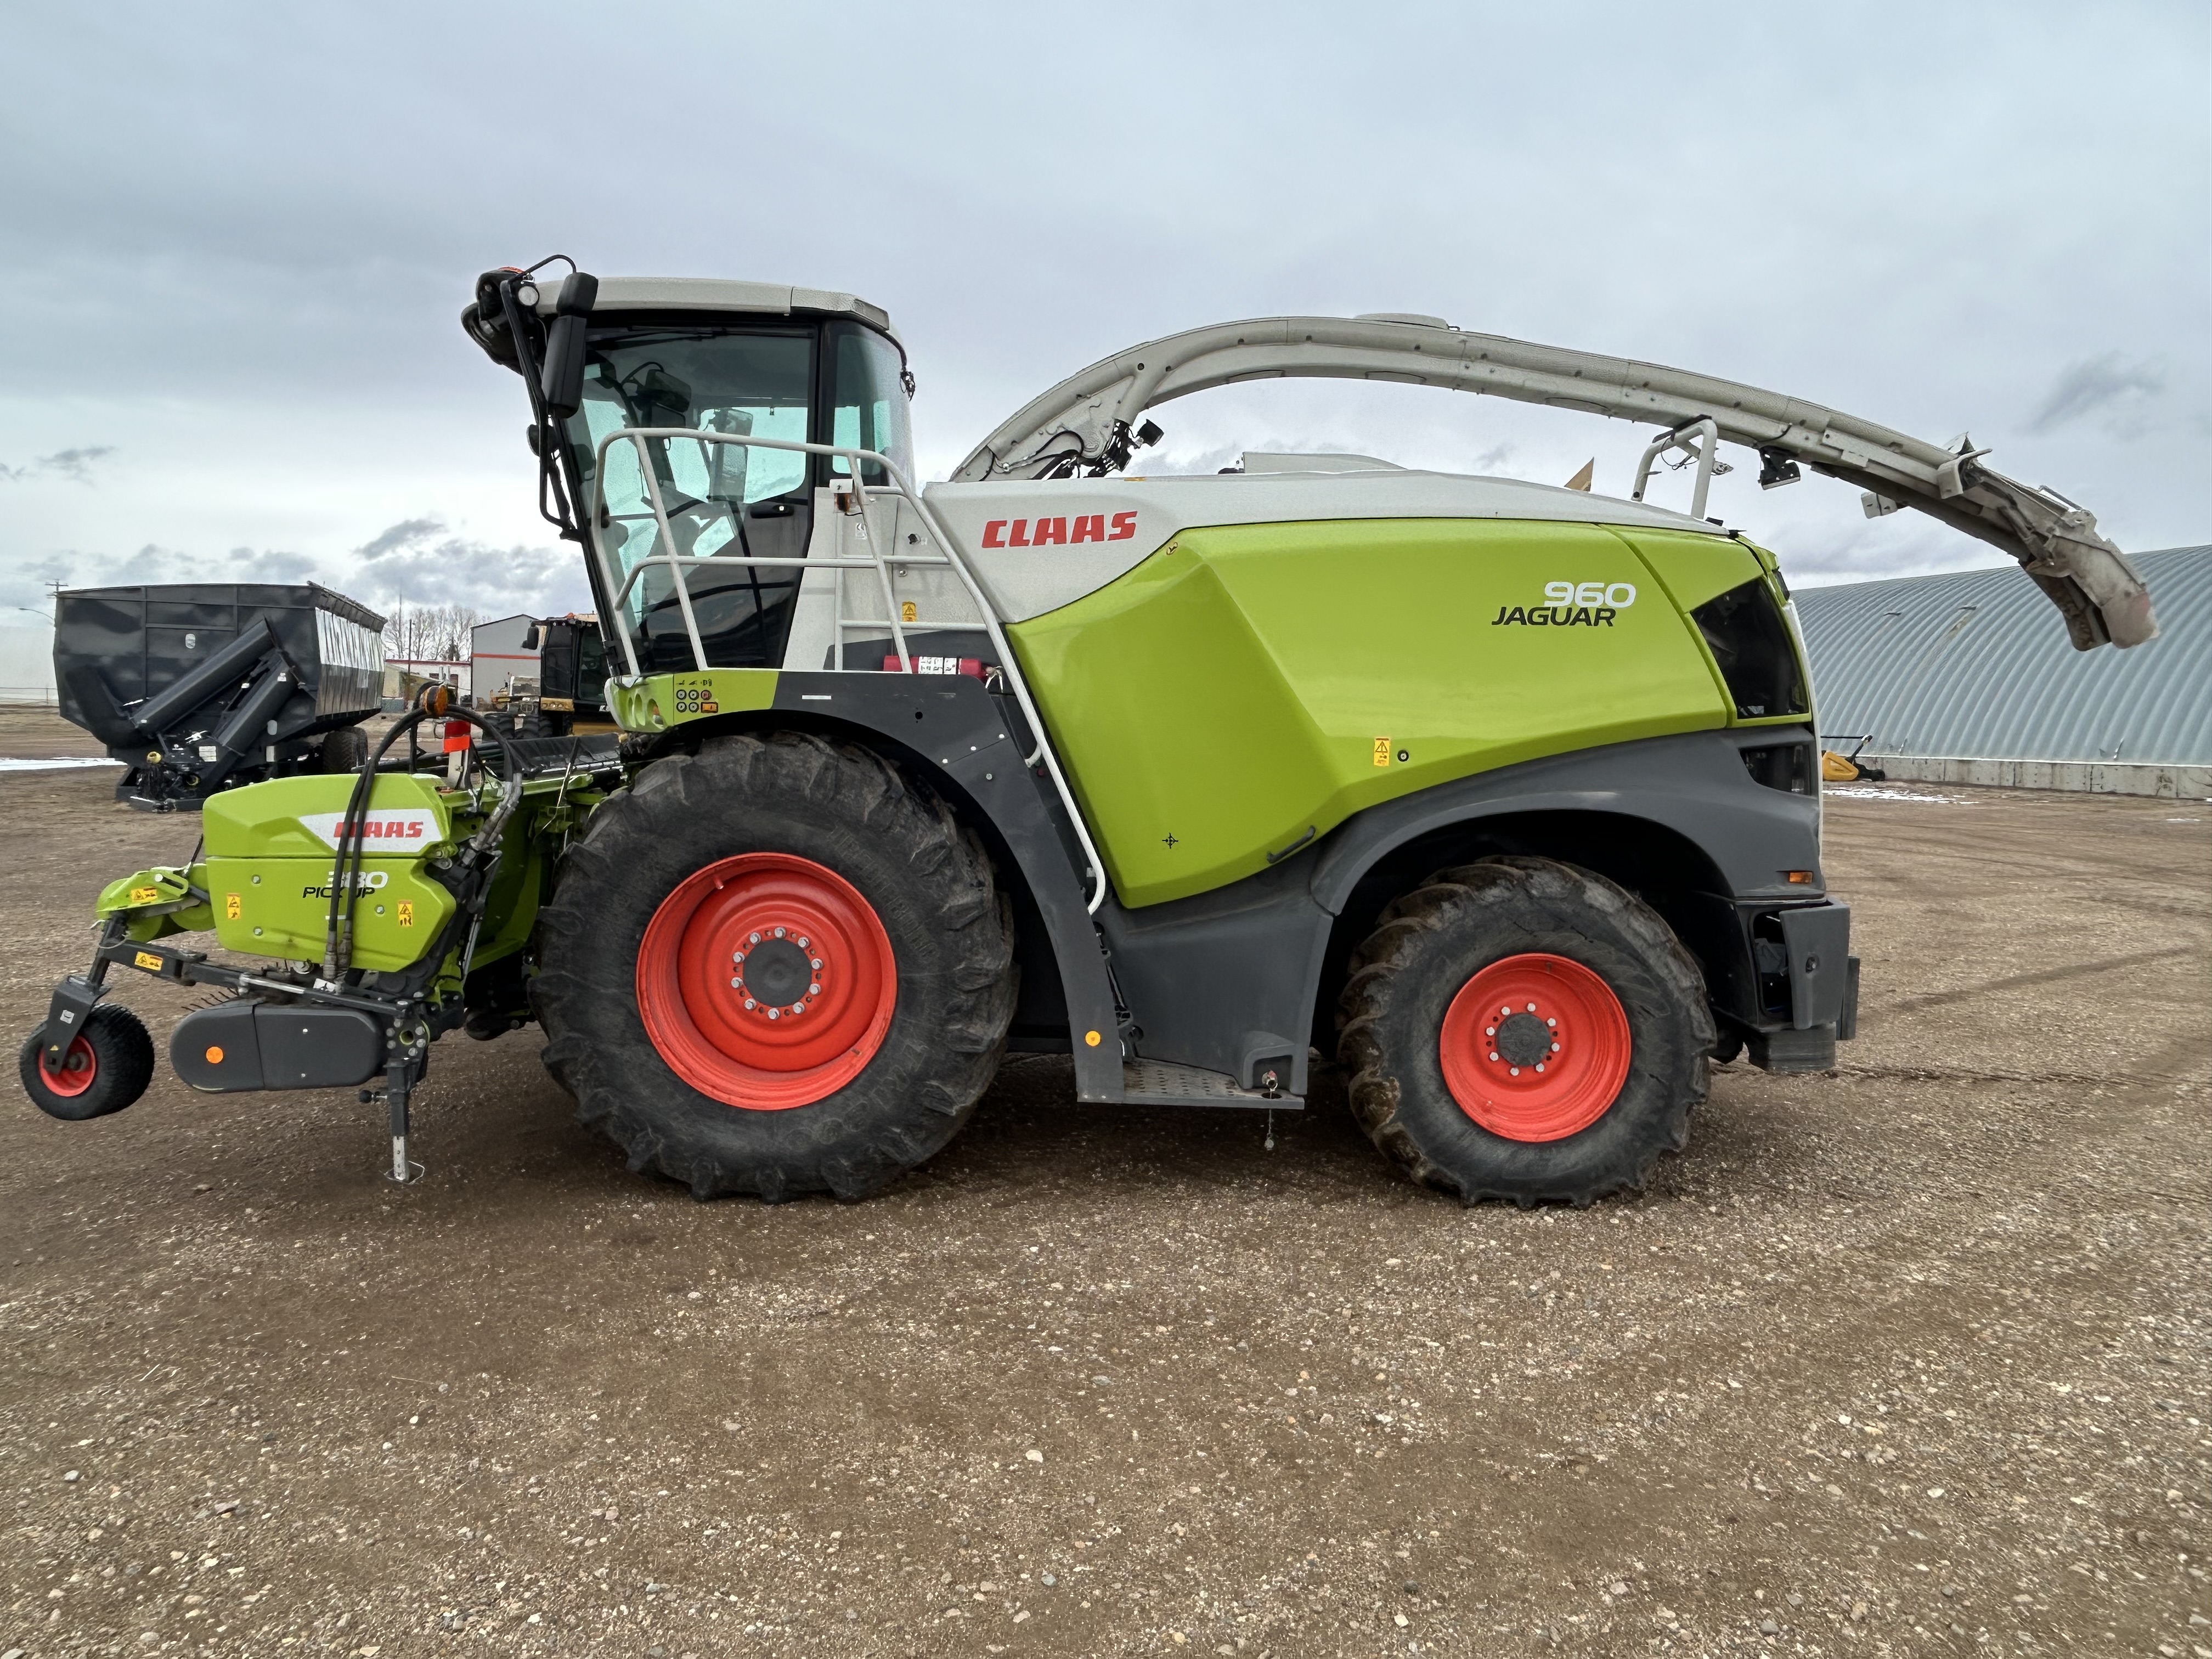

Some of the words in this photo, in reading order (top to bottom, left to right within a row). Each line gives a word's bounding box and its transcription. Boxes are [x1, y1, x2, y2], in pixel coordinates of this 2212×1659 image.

[981, 511, 1138, 548] CLAAS
[1544, 580, 1637, 608] 960
[1491, 606, 1616, 627] JAGUAR
